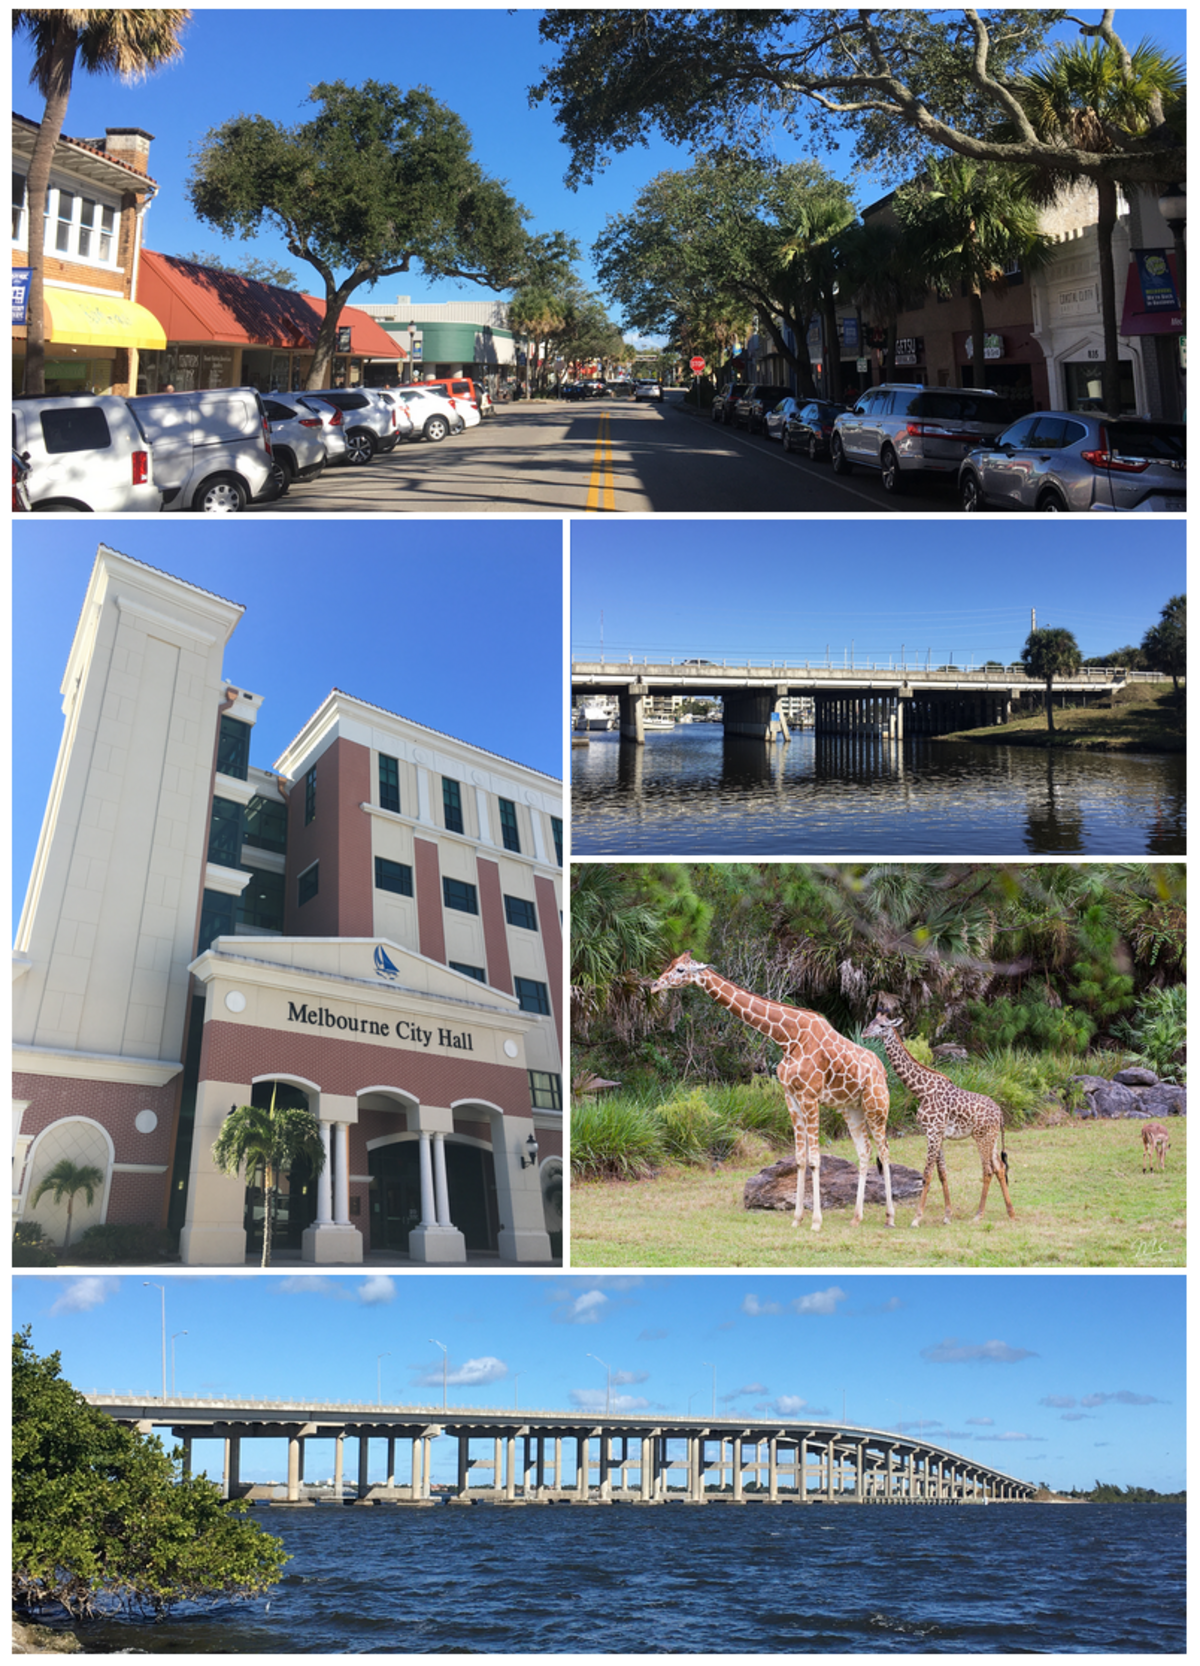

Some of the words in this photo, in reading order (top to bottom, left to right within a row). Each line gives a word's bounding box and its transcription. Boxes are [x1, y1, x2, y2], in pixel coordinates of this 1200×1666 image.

[287, 1001, 390, 1037] Melbourne
[396, 1020, 432, 1047] City
[437, 1028, 474, 1051] Hall
